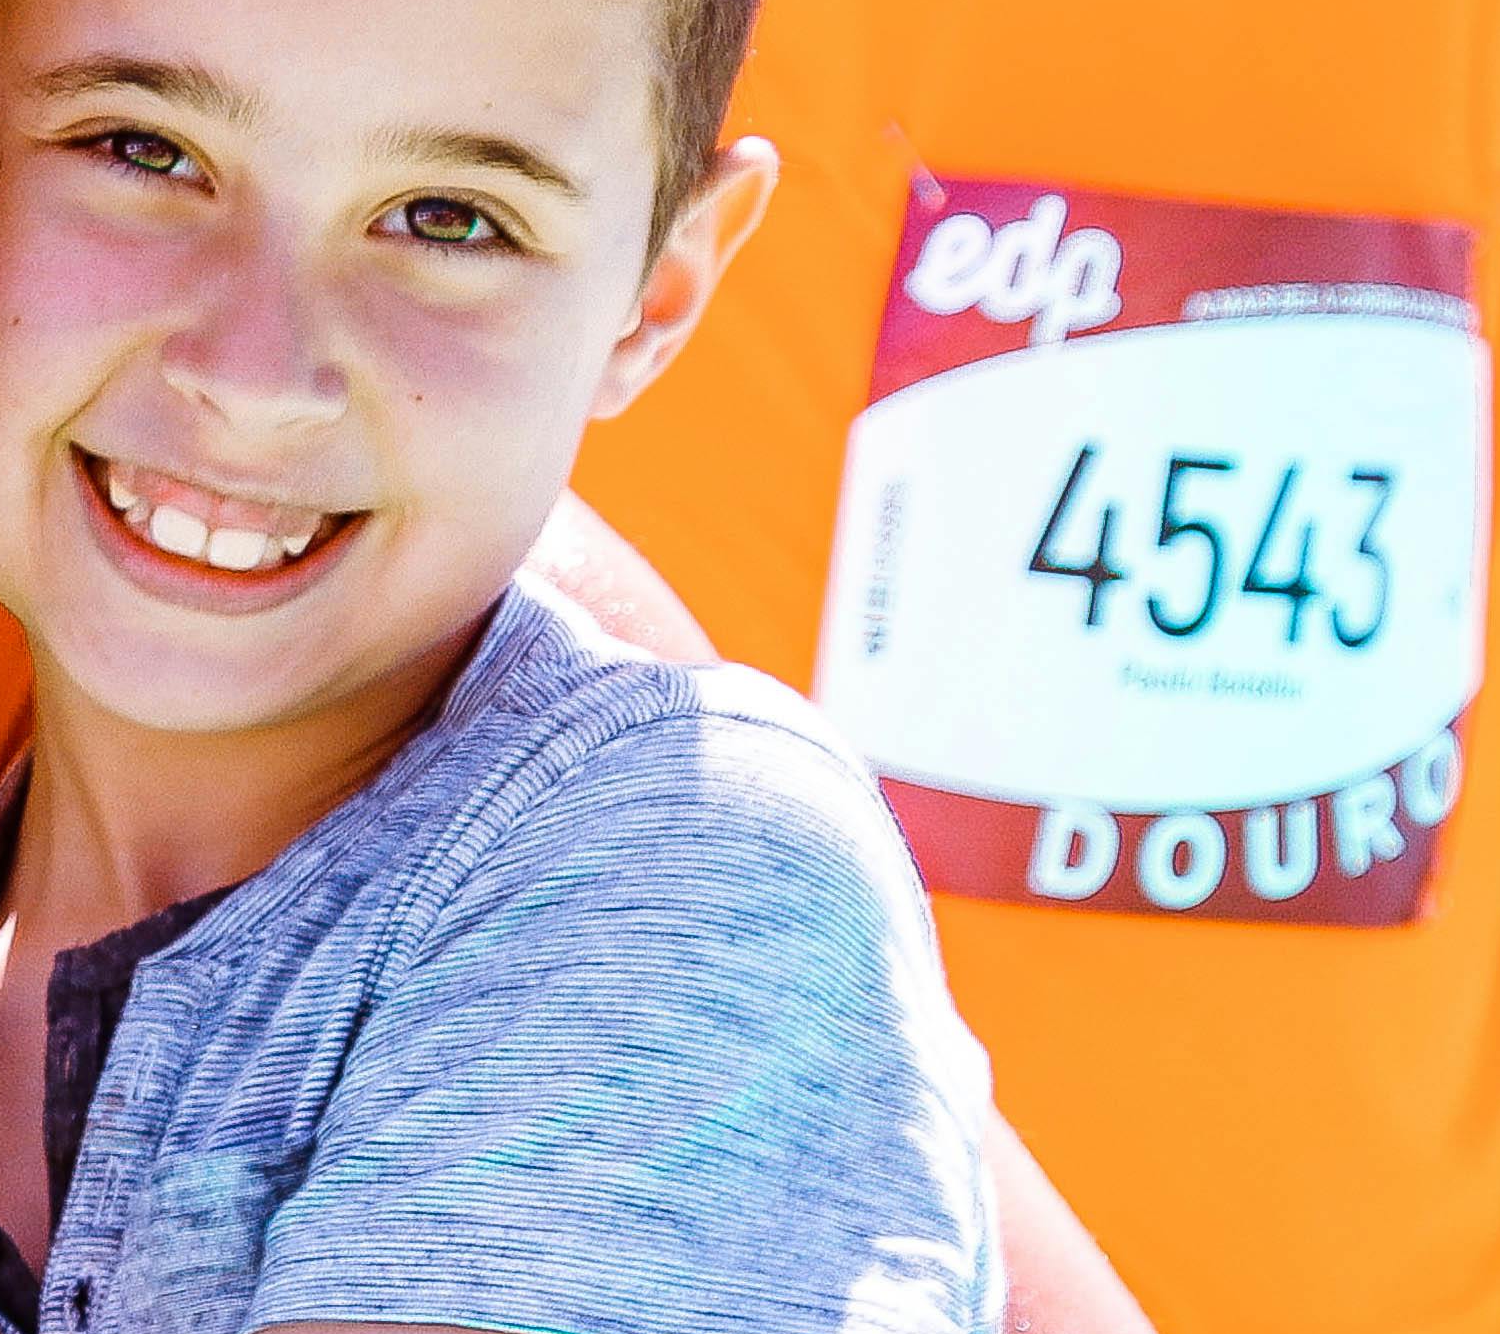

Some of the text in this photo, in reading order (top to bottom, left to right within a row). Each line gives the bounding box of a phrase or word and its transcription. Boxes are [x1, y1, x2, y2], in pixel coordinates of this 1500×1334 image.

[904, 192, 1125, 345] edp
[1027, 441, 1398, 651] 4543
[1026, 723, 1464, 911] DOURO
